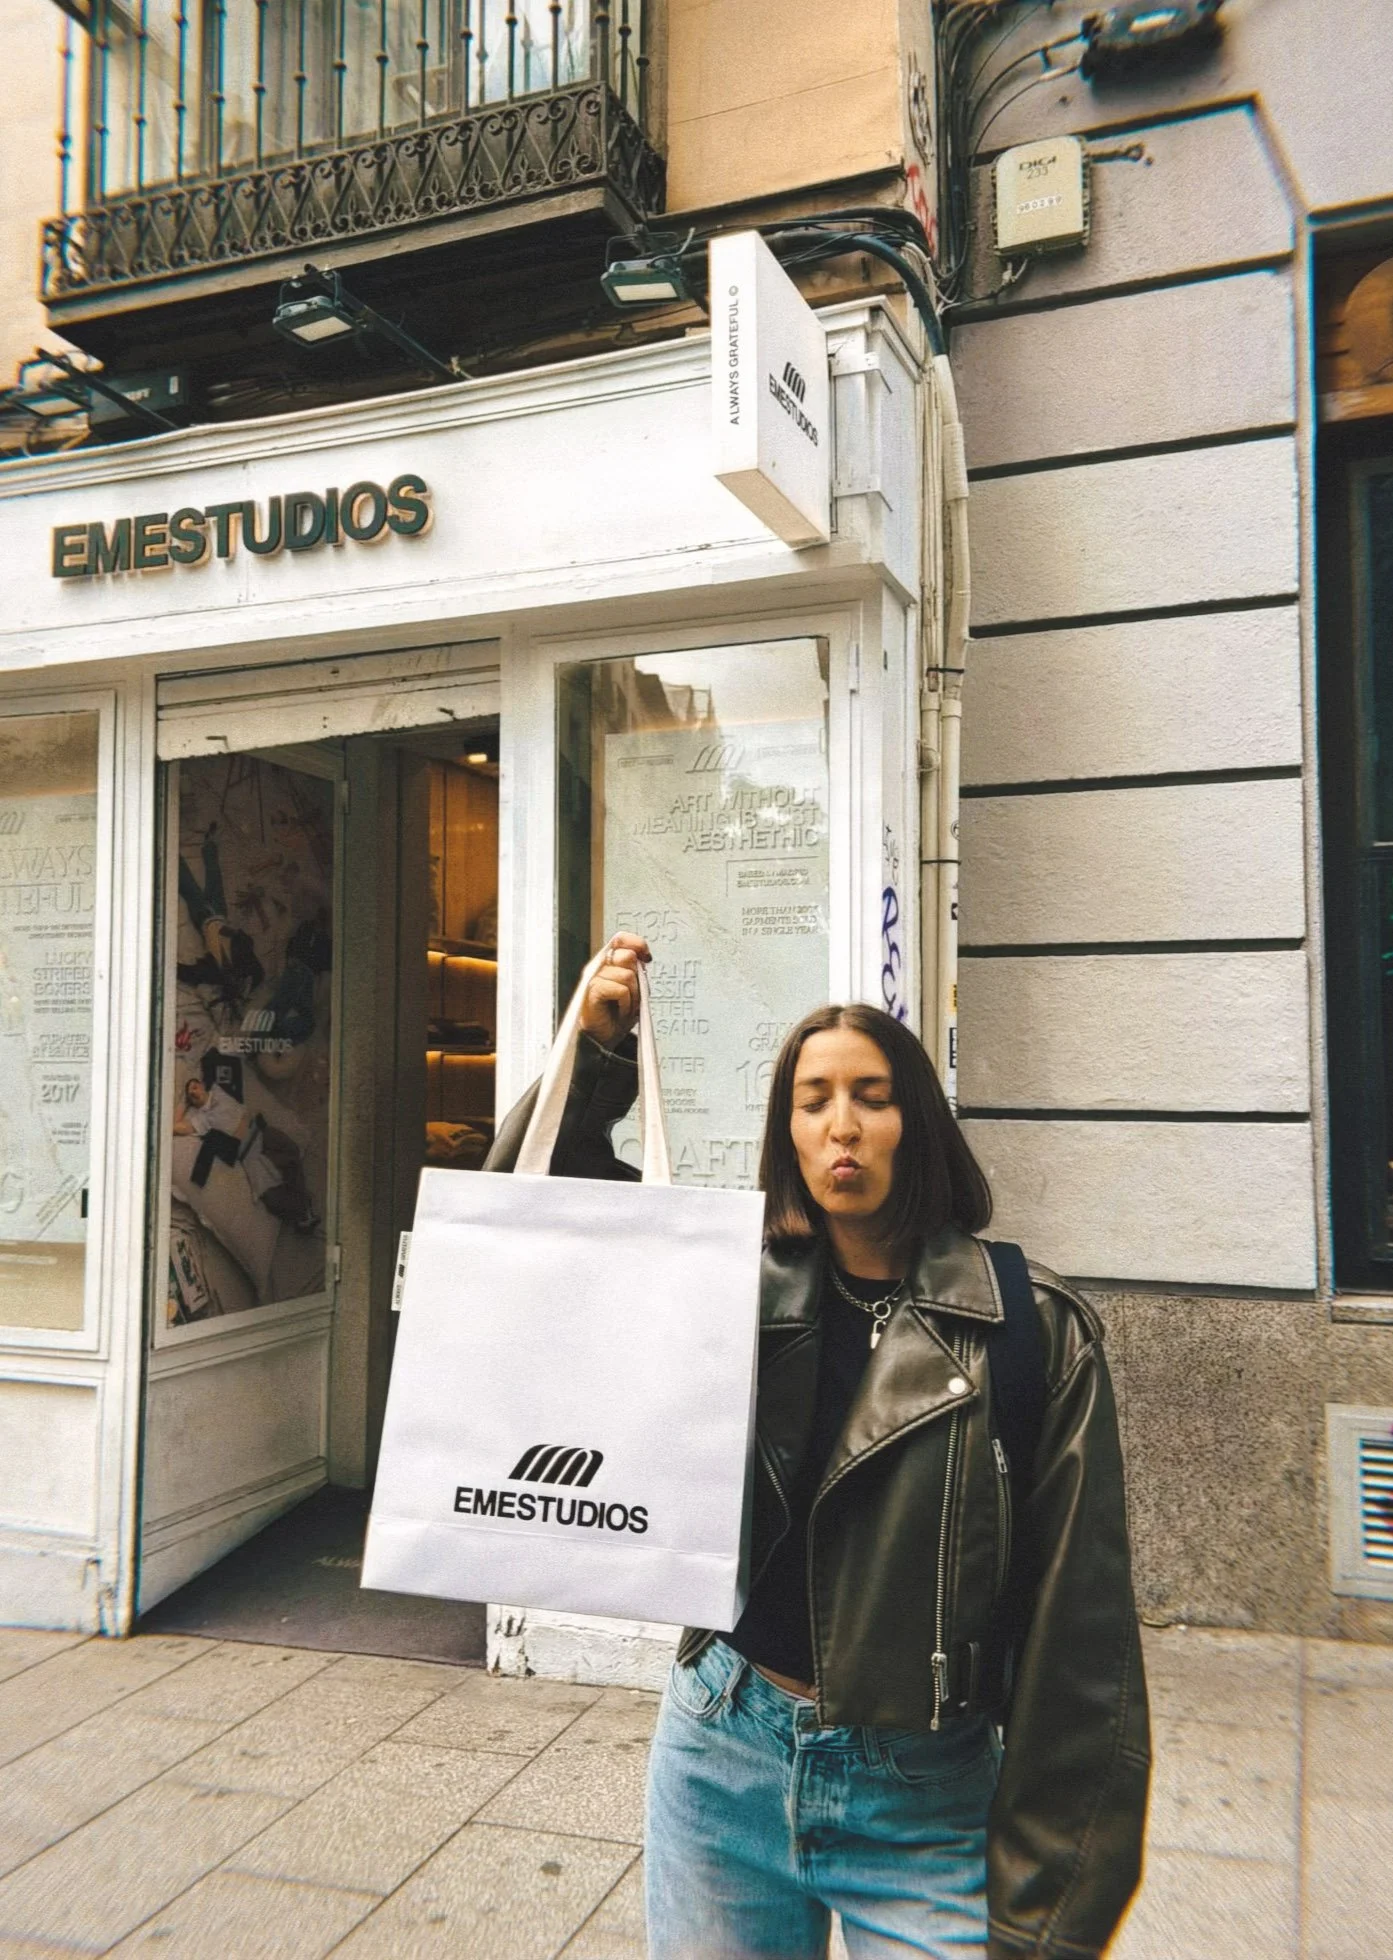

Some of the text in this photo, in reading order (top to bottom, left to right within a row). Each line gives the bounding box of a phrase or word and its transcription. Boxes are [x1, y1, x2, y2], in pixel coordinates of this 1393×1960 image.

[728, 298, 739, 368] GRATEFUL
[728, 370, 740, 426] ALWAYS
[768, 372, 819, 448] EMESTUDIOS
[52, 473, 433, 579] EMESTUDIOS
[669, 785, 822, 815] ART WITHOUT
[219, 1036, 294, 1054] EMESTUDIOS
[41, 1083, 81, 1104] 2017
[453, 1485, 649, 1534] EMESTUDIOS
